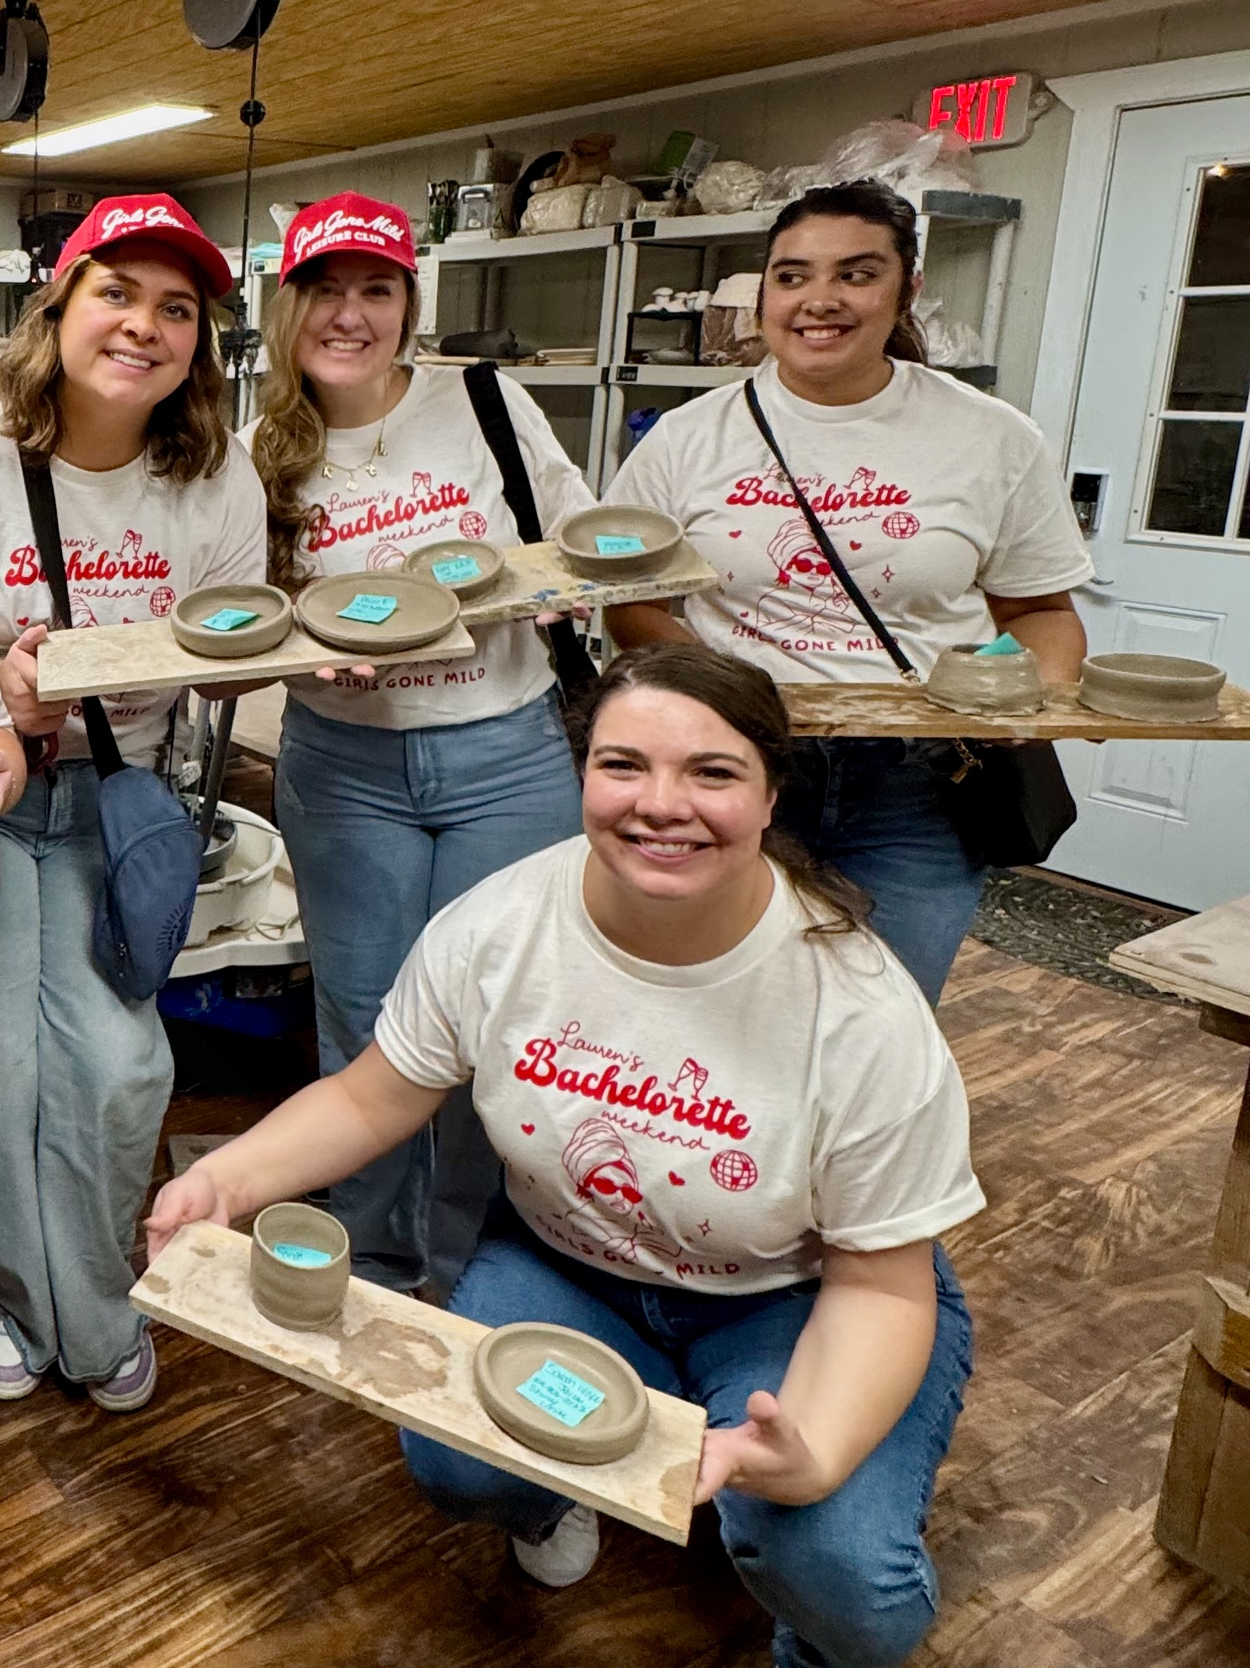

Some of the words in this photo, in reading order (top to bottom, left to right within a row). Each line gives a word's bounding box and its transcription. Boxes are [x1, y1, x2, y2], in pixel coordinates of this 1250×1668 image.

[928, 75, 1017, 143] EXIT
[101, 208, 145, 240] Girls
[145, 206, 185, 229] Gon
[293, 220, 324, 264] Girls
[323, 210, 365, 238] Gone
[363, 215, 405, 242] Mild
[306, 481, 471, 553] Bachelorette
[327, 491, 390, 514] Lauren's
[377, 514, 455, 544] weekend
[72, 583, 150, 599] weekend
[781, 638, 836, 652] GONE
[333, 677, 380, 692] GIRLS
[385, 674, 435, 689] GONE
[443, 667, 486, 685] MILD
[556, 1020, 645, 1073] Lauren's
[513, 1037, 752, 1140] Bachelorette
[600, 1110, 711, 1151] weekend
[675, 1262, 741, 1281] MILD
